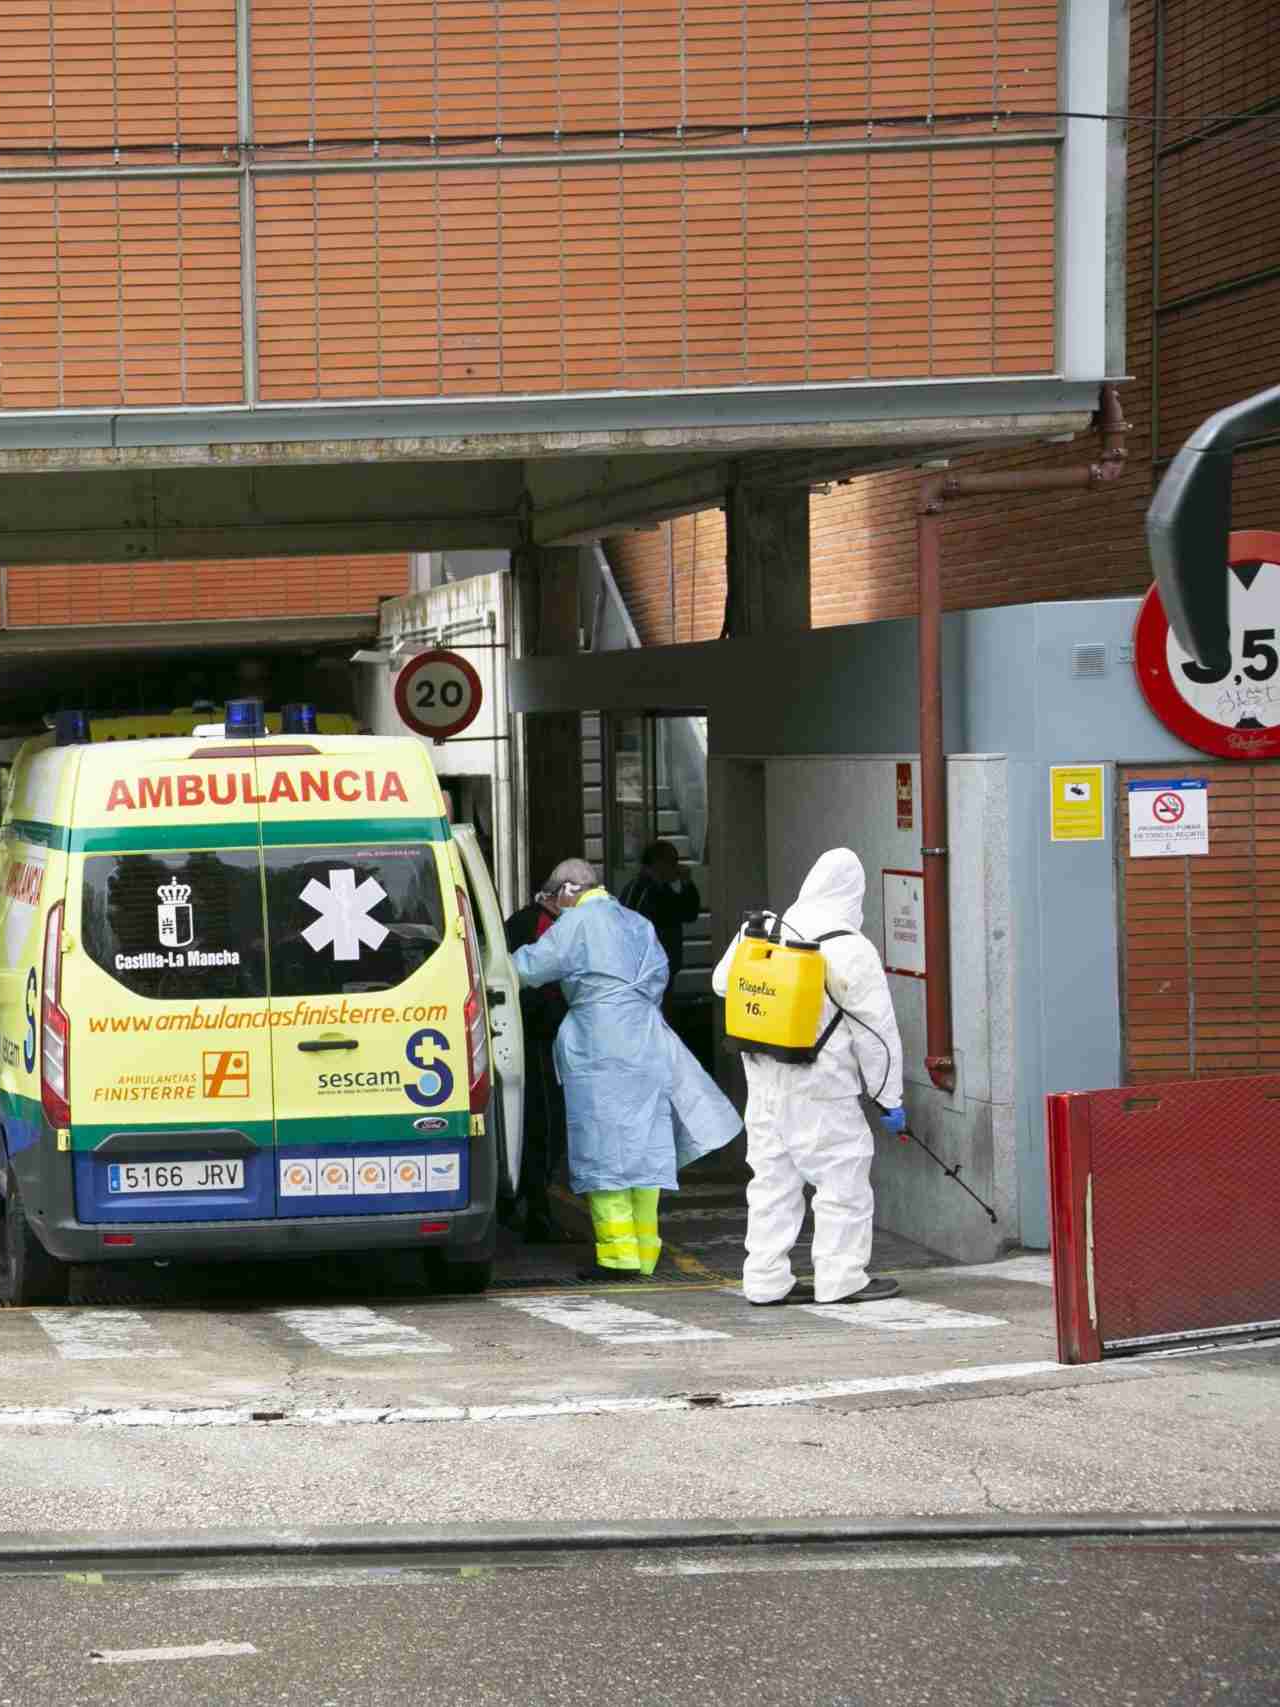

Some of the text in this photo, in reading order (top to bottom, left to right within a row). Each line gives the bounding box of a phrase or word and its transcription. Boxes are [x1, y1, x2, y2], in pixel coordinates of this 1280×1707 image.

[415, 680, 463, 707] 20
[106, 770, 409, 811] AMBULANCIA
[114, 949, 240, 970] Castilla-La Mancha
[117, 1073, 198, 1085] AMBULANCIAS
[318, 1070, 401, 1089] sescam
[93, 1086, 196, 1102] FINISTERRE
[125, 1164, 238, 1188] 5166 JRV
